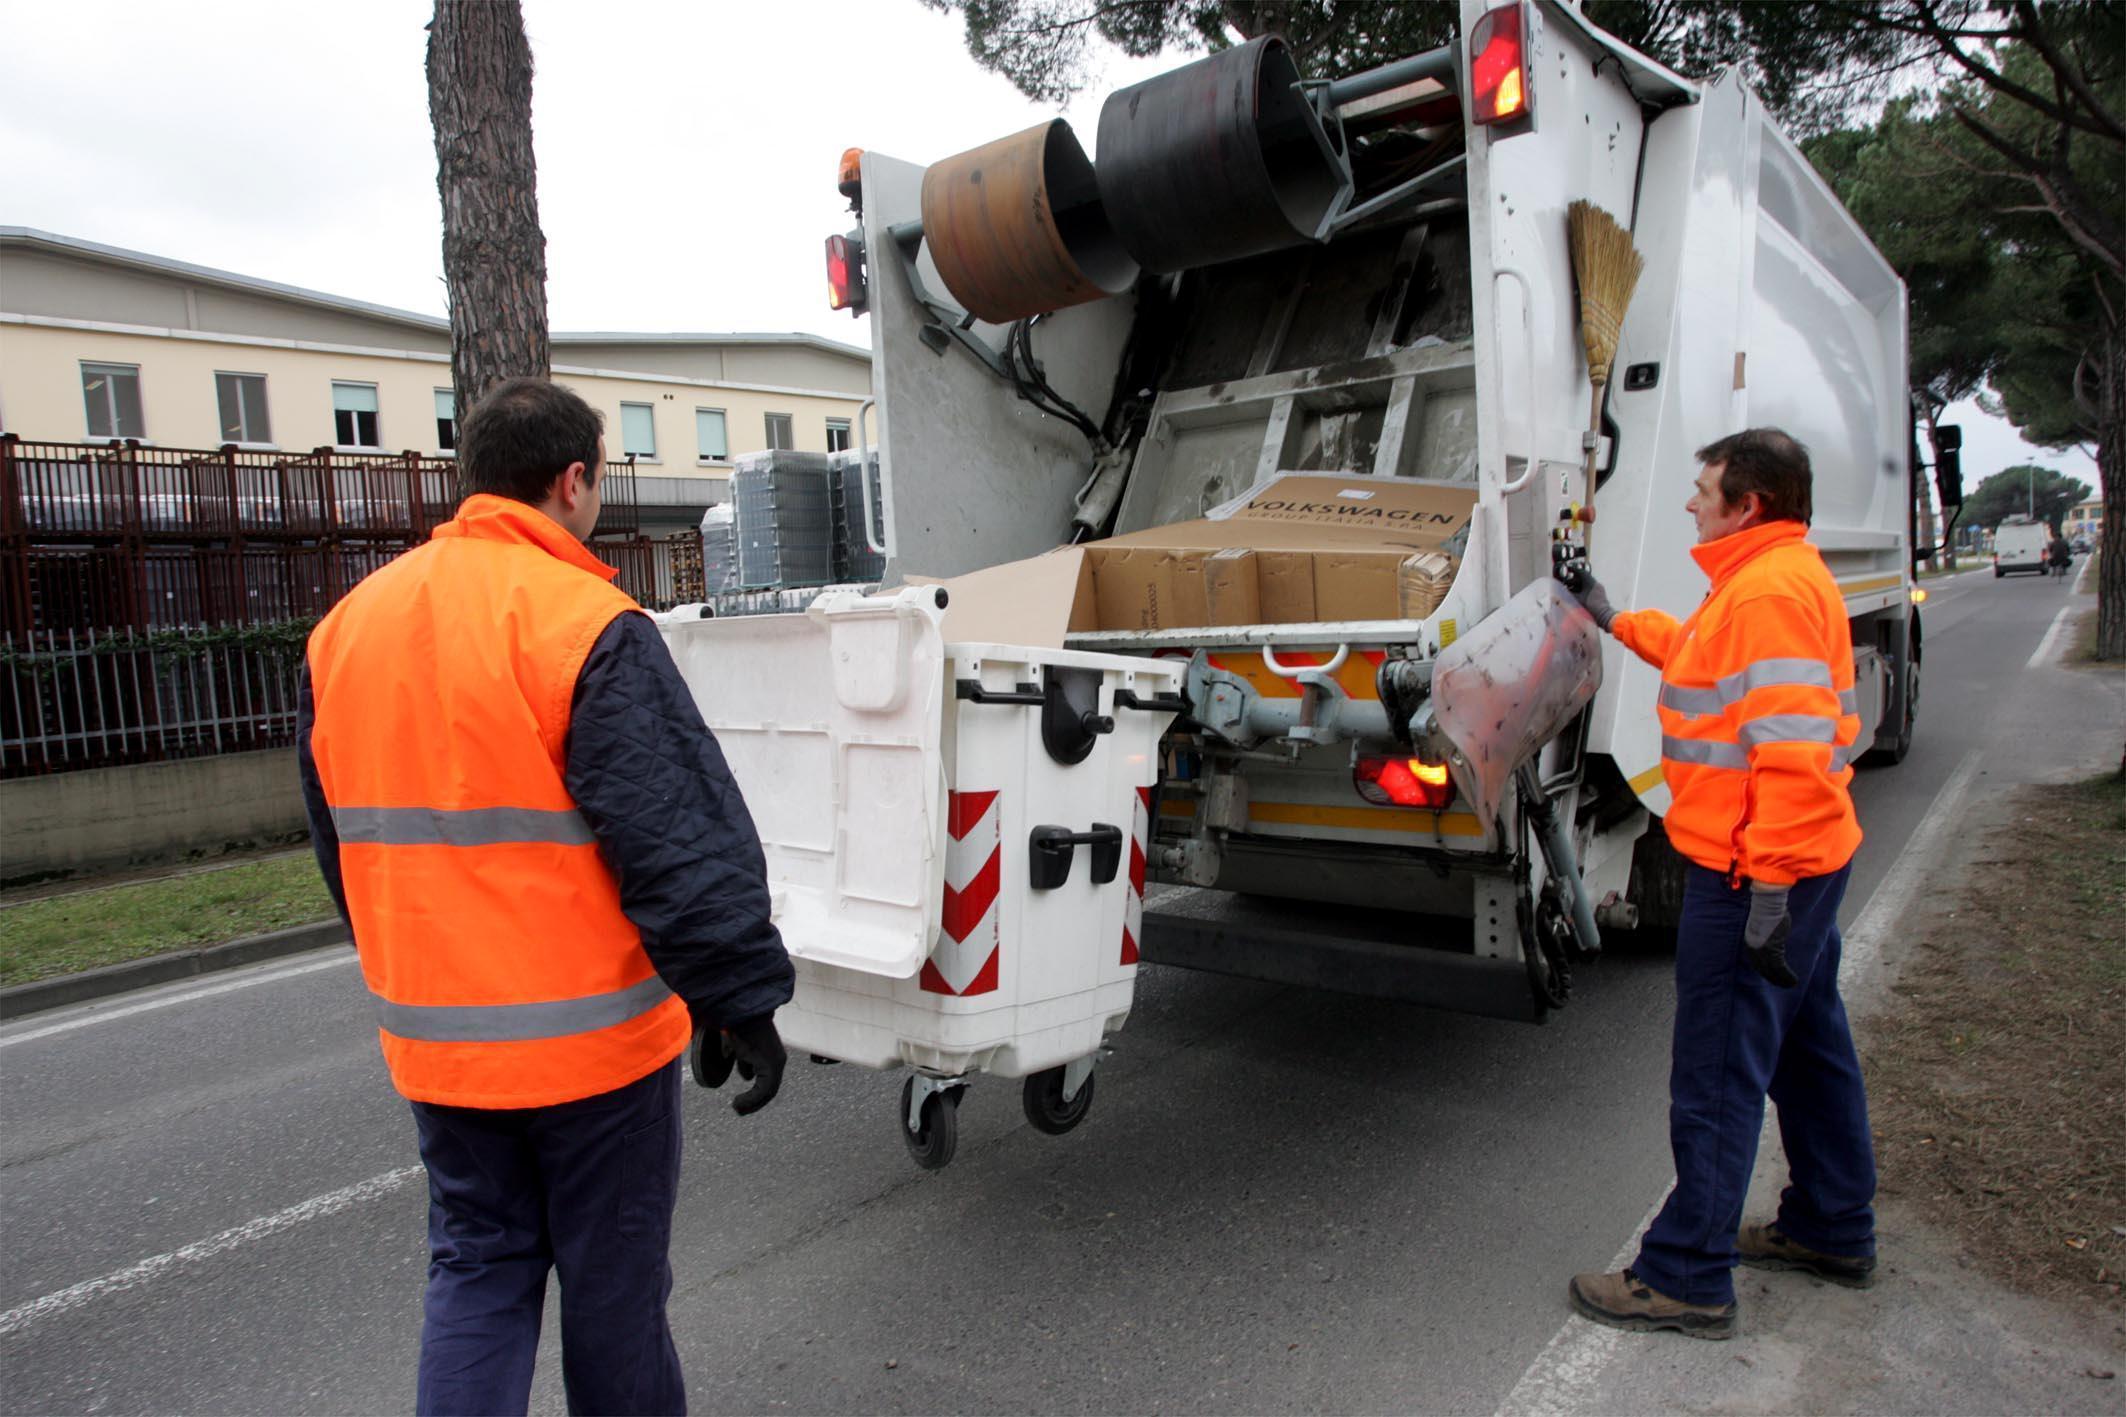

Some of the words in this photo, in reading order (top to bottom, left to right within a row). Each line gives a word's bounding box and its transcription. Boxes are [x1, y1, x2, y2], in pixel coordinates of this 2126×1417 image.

[1247, 501, 1455, 524] VOLKSWAGEN
[1247, 511, 1309, 520] GROUP
[1314, 514, 1375, 525] ITALIA
